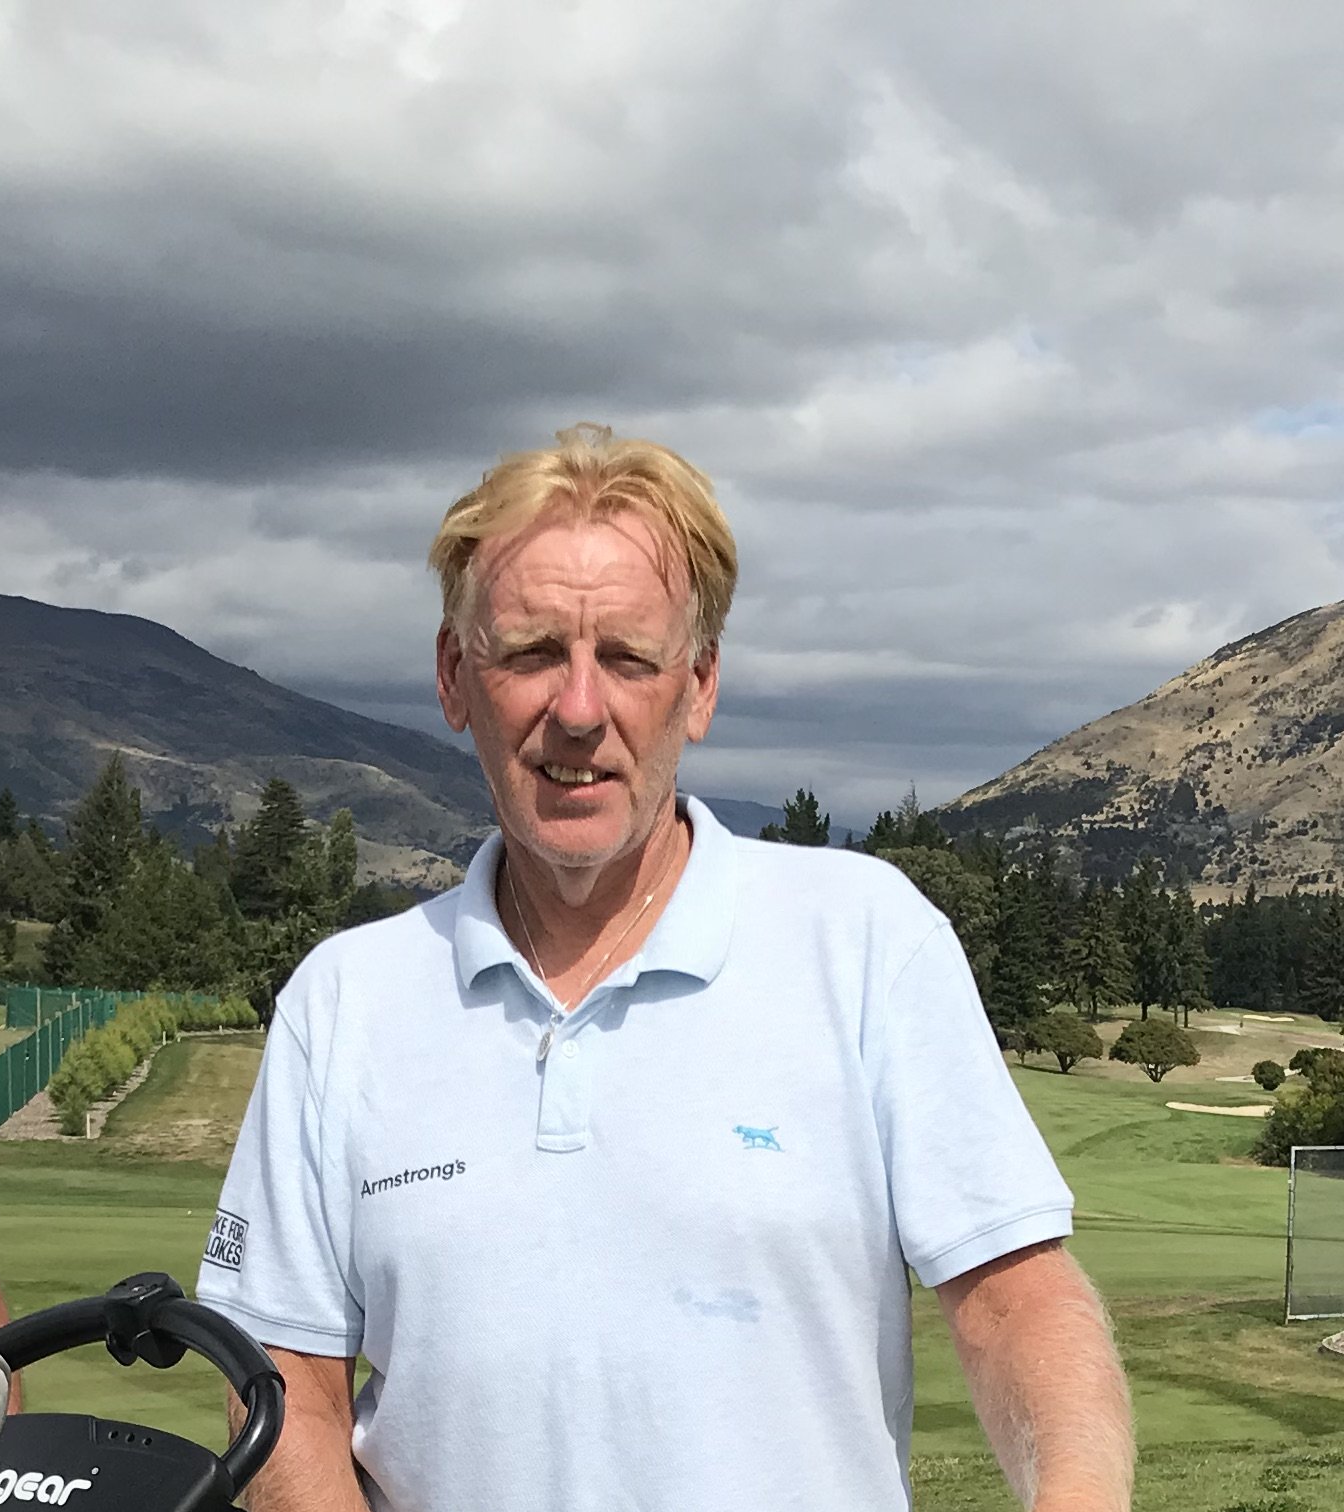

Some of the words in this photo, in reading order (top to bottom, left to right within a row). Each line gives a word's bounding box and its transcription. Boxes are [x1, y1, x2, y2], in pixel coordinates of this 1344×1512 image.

[360, 1159, 466, 1199] Armstrong's
[213, 1214, 228, 1236] KE
[228, 1220, 245, 1243] FOR
[205, 1233, 243, 1266] LOKES
